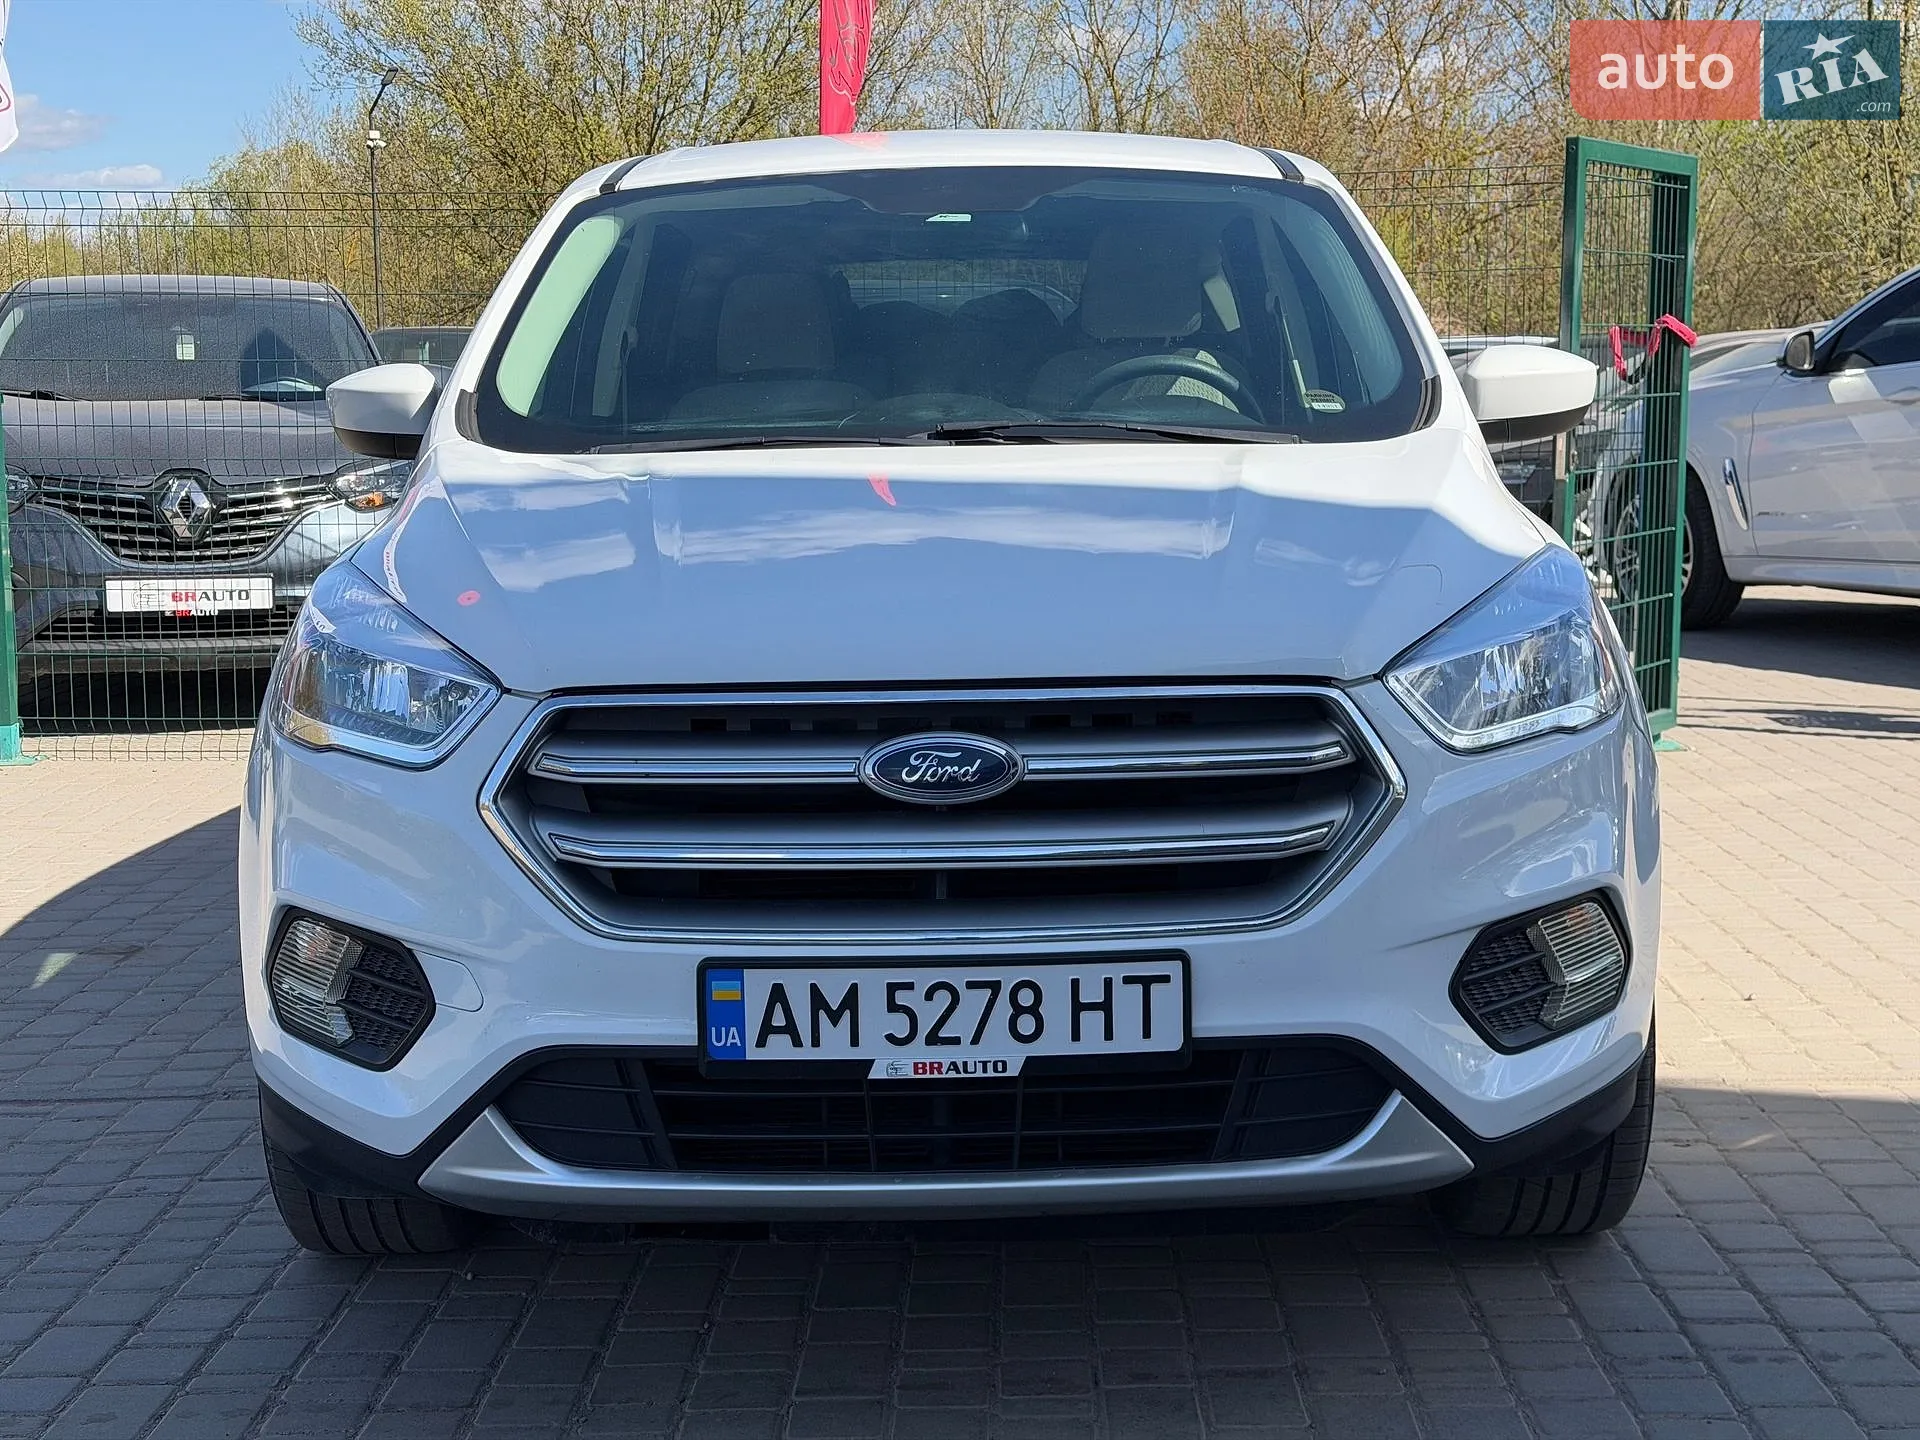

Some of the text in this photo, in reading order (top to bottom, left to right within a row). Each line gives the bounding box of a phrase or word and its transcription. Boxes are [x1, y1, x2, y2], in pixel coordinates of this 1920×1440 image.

[171, 590, 250, 602] BRAUTO
[902, 750, 982, 783] Ford
[754, 974, 1172, 1048] AM 5278 HT
[711, 1027, 741, 1047] UA
[913, 1060, 1008, 1076] BRAUTO
